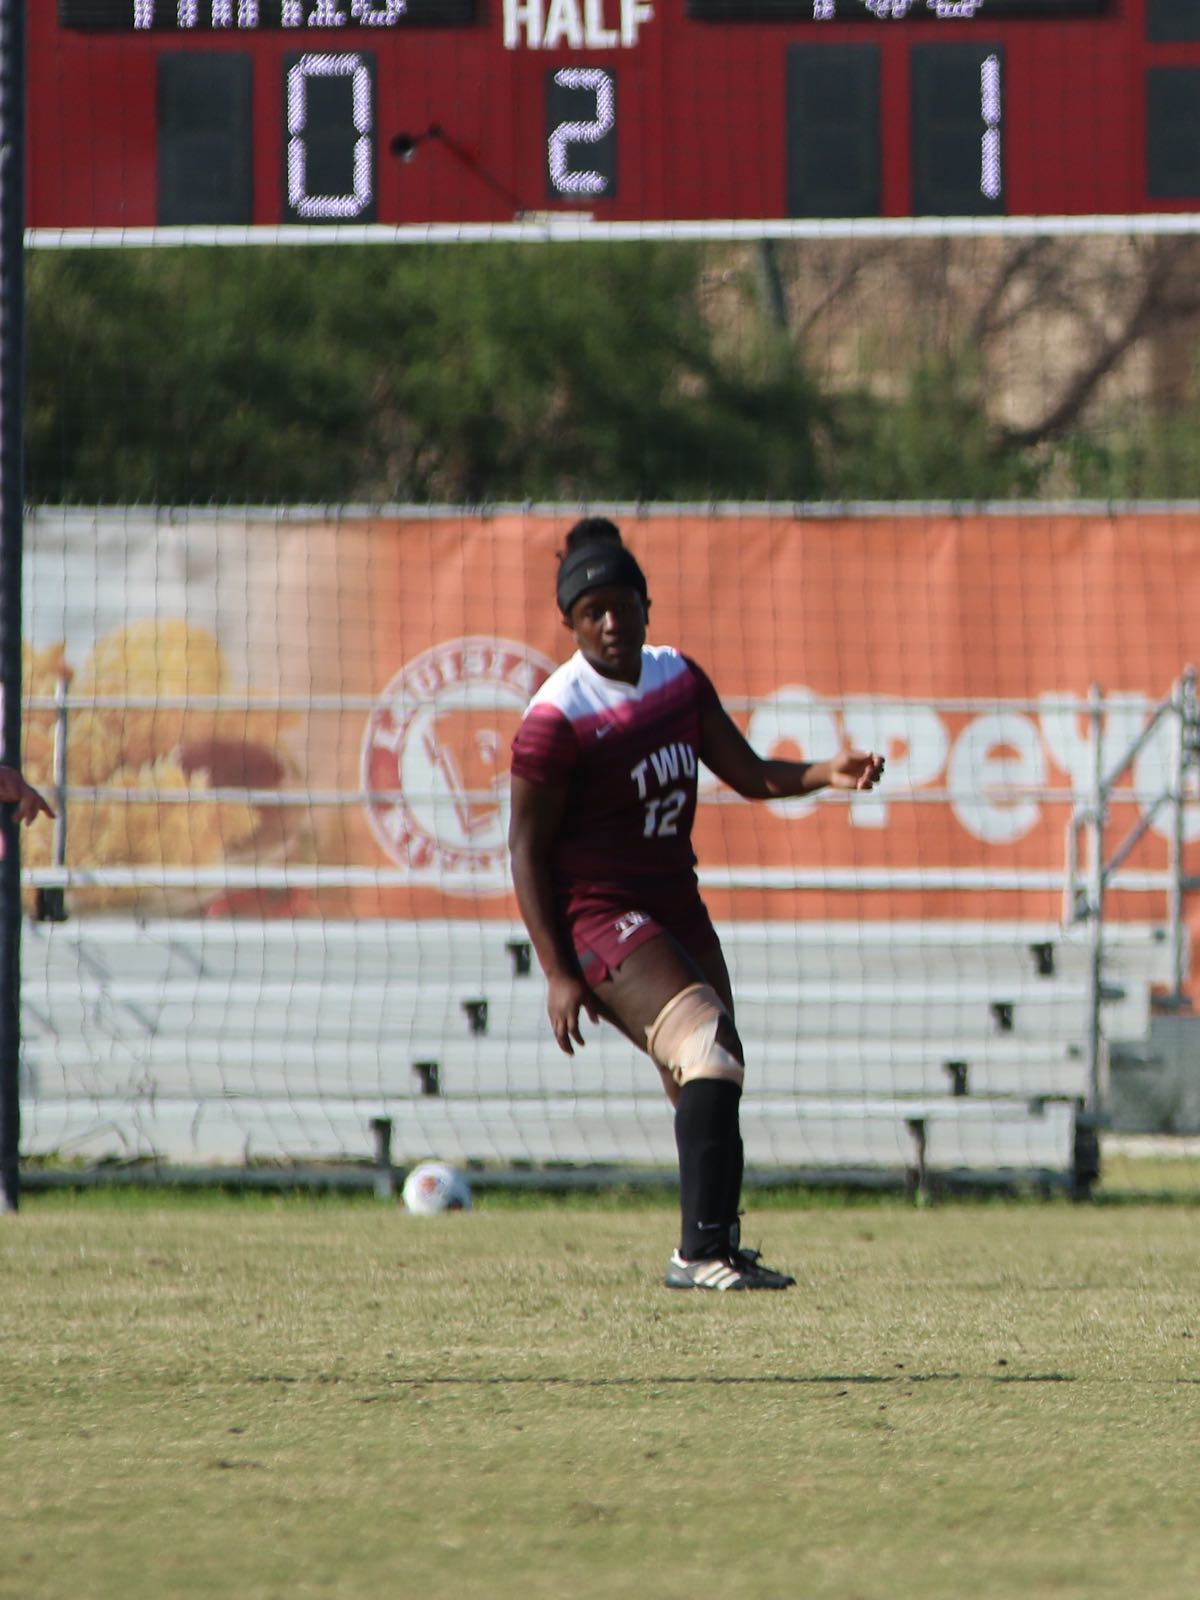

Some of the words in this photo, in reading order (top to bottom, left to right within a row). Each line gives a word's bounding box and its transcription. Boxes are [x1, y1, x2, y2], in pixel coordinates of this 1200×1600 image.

[503, 0, 655, 49] HALF
[288, 53, 372, 217] 0
[549, 68, 614, 192] 2
[981, 54, 1000, 199] 1
[631, 742, 697, 800] TWU
[643, 790, 687, 838] 12
